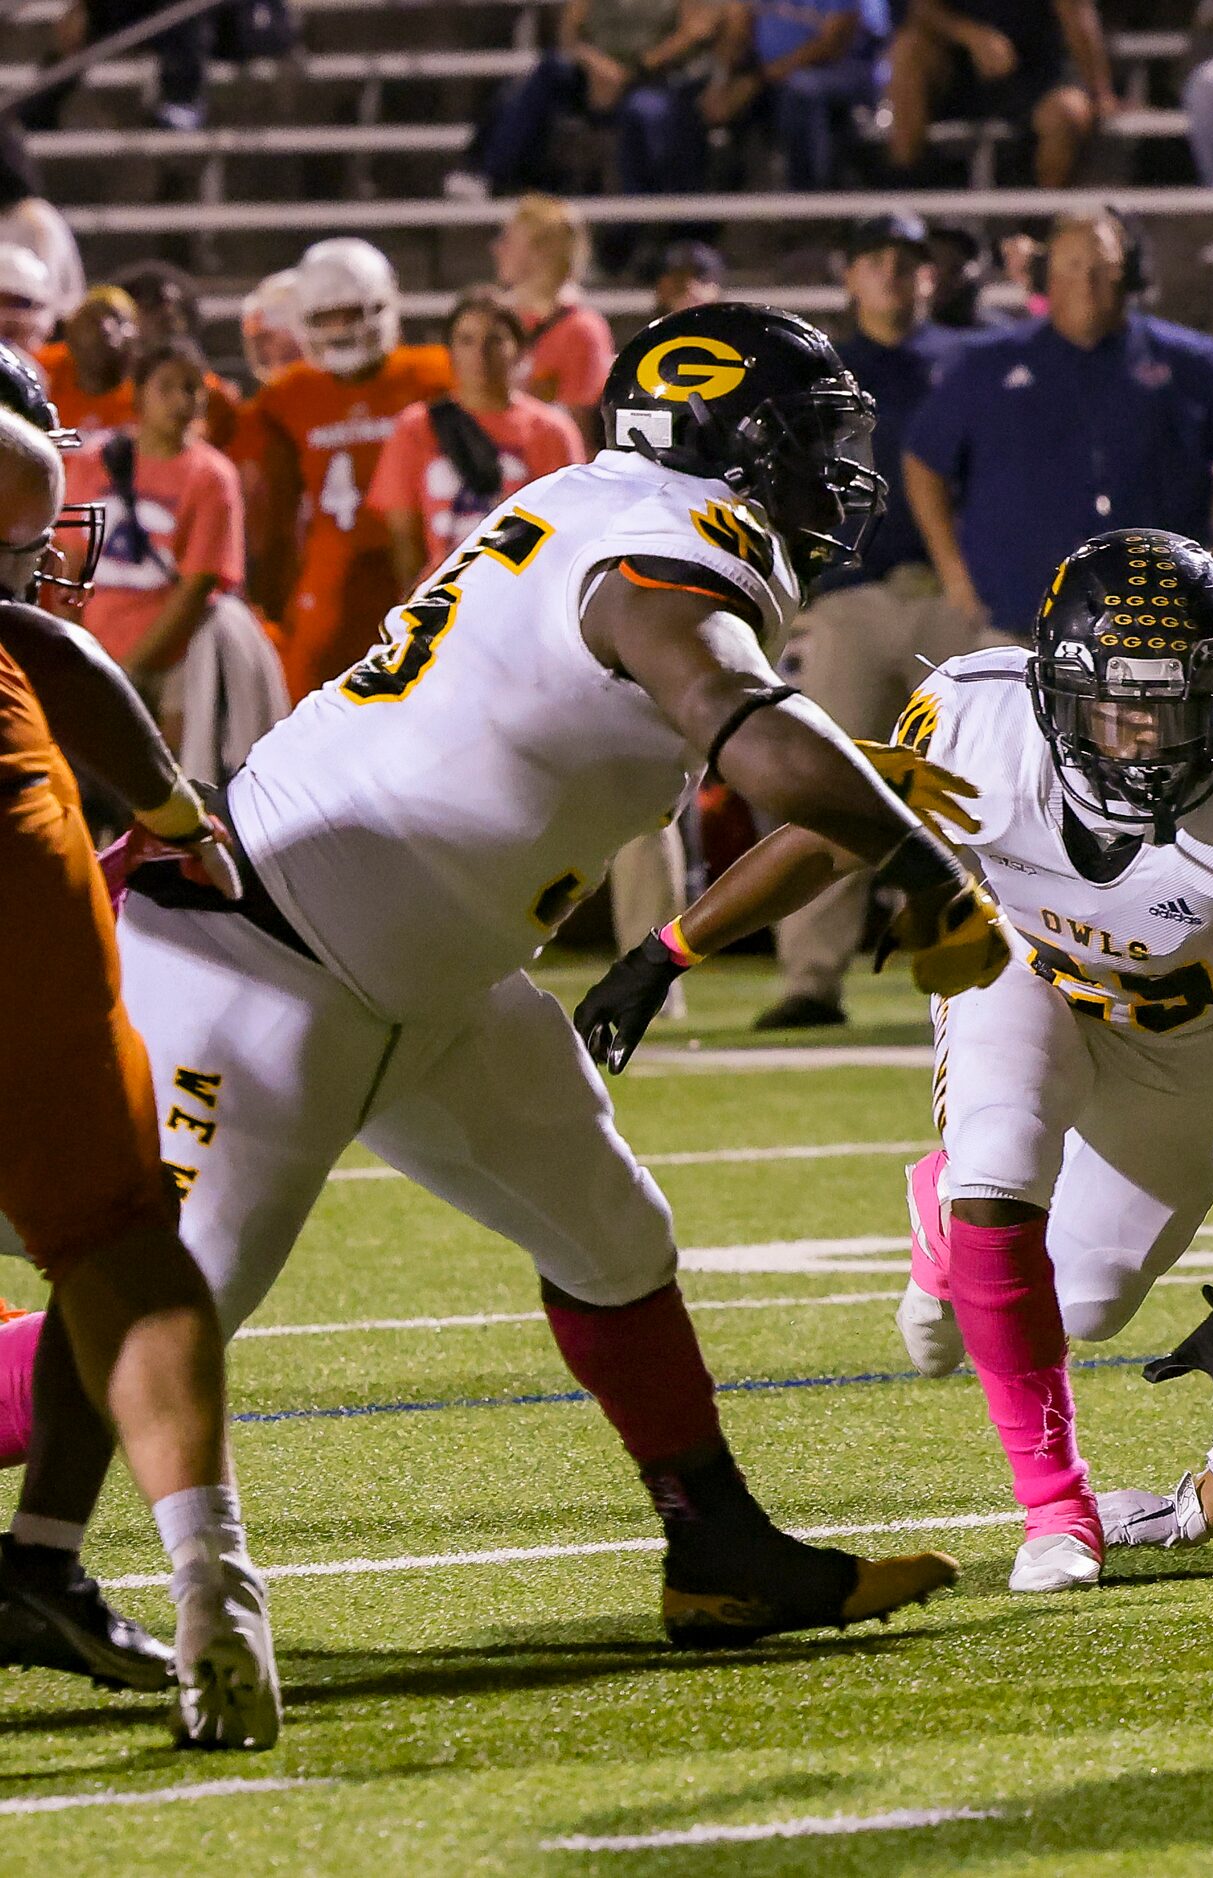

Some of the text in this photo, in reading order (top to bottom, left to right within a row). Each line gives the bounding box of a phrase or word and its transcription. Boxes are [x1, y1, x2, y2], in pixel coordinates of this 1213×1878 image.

[636, 336, 746, 402] G
[1128, 576, 1178, 588] G G
[1104, 595, 1121, 606] G
[1126, 596, 1144, 606] G
[1152, 596, 1169, 606] G
[1115, 614, 1179, 627] G G G
[1101, 634, 1188, 651] G G G G
[1149, 907, 1202, 924] adidas
[1040, 906, 1151, 962] OWLS
[166, 1065, 223, 1148] WE
